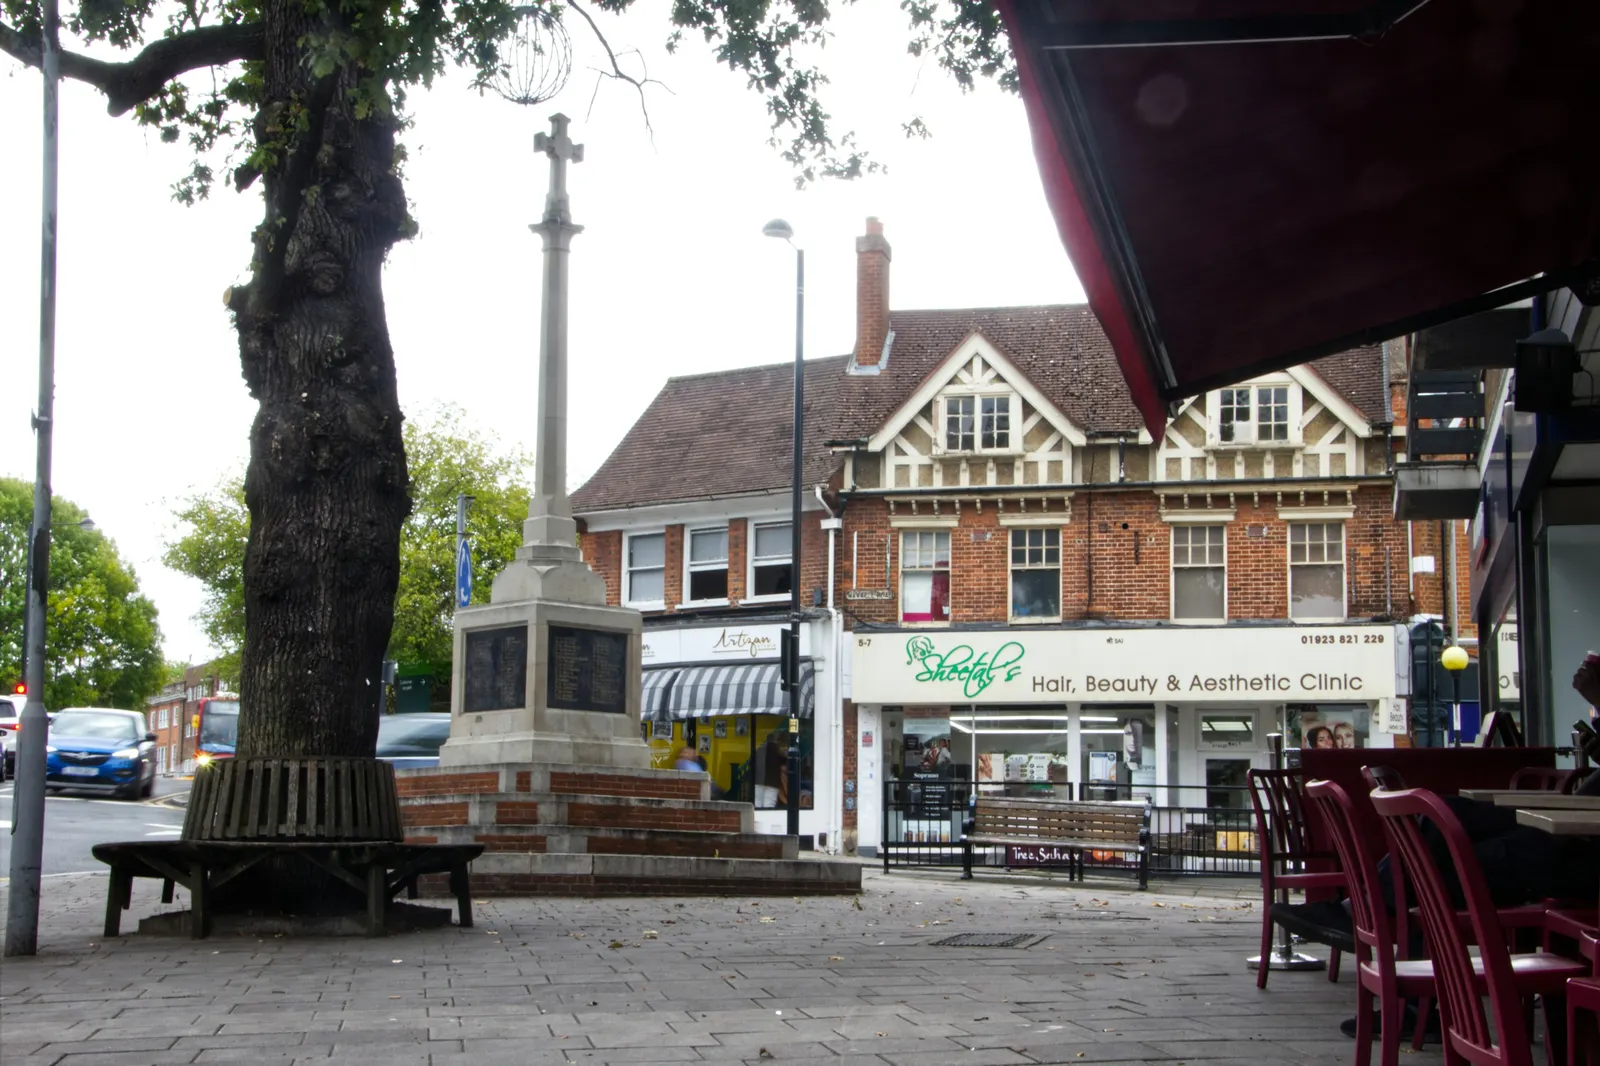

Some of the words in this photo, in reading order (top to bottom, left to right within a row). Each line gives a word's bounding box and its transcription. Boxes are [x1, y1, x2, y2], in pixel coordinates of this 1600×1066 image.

[713, 628, 770, 658] Artizan
[858, 639, 872, 647] 5-7
[1301, 635, 1335, 644] 01923
[1339, 635, 1359, 644] 821
[1364, 634, 1385, 643] 229
[915, 641, 1025, 698] Sheetal's
[1032, 676, 1077, 694] Hair,
[1086, 675, 1158, 695] Beauty
[1166, 674, 1181, 691] &
[1189, 673, 1291, 691] Aesthetic
[1300, 673, 1363, 691] Clinic
[913, 772, 939, 780] Soprano
